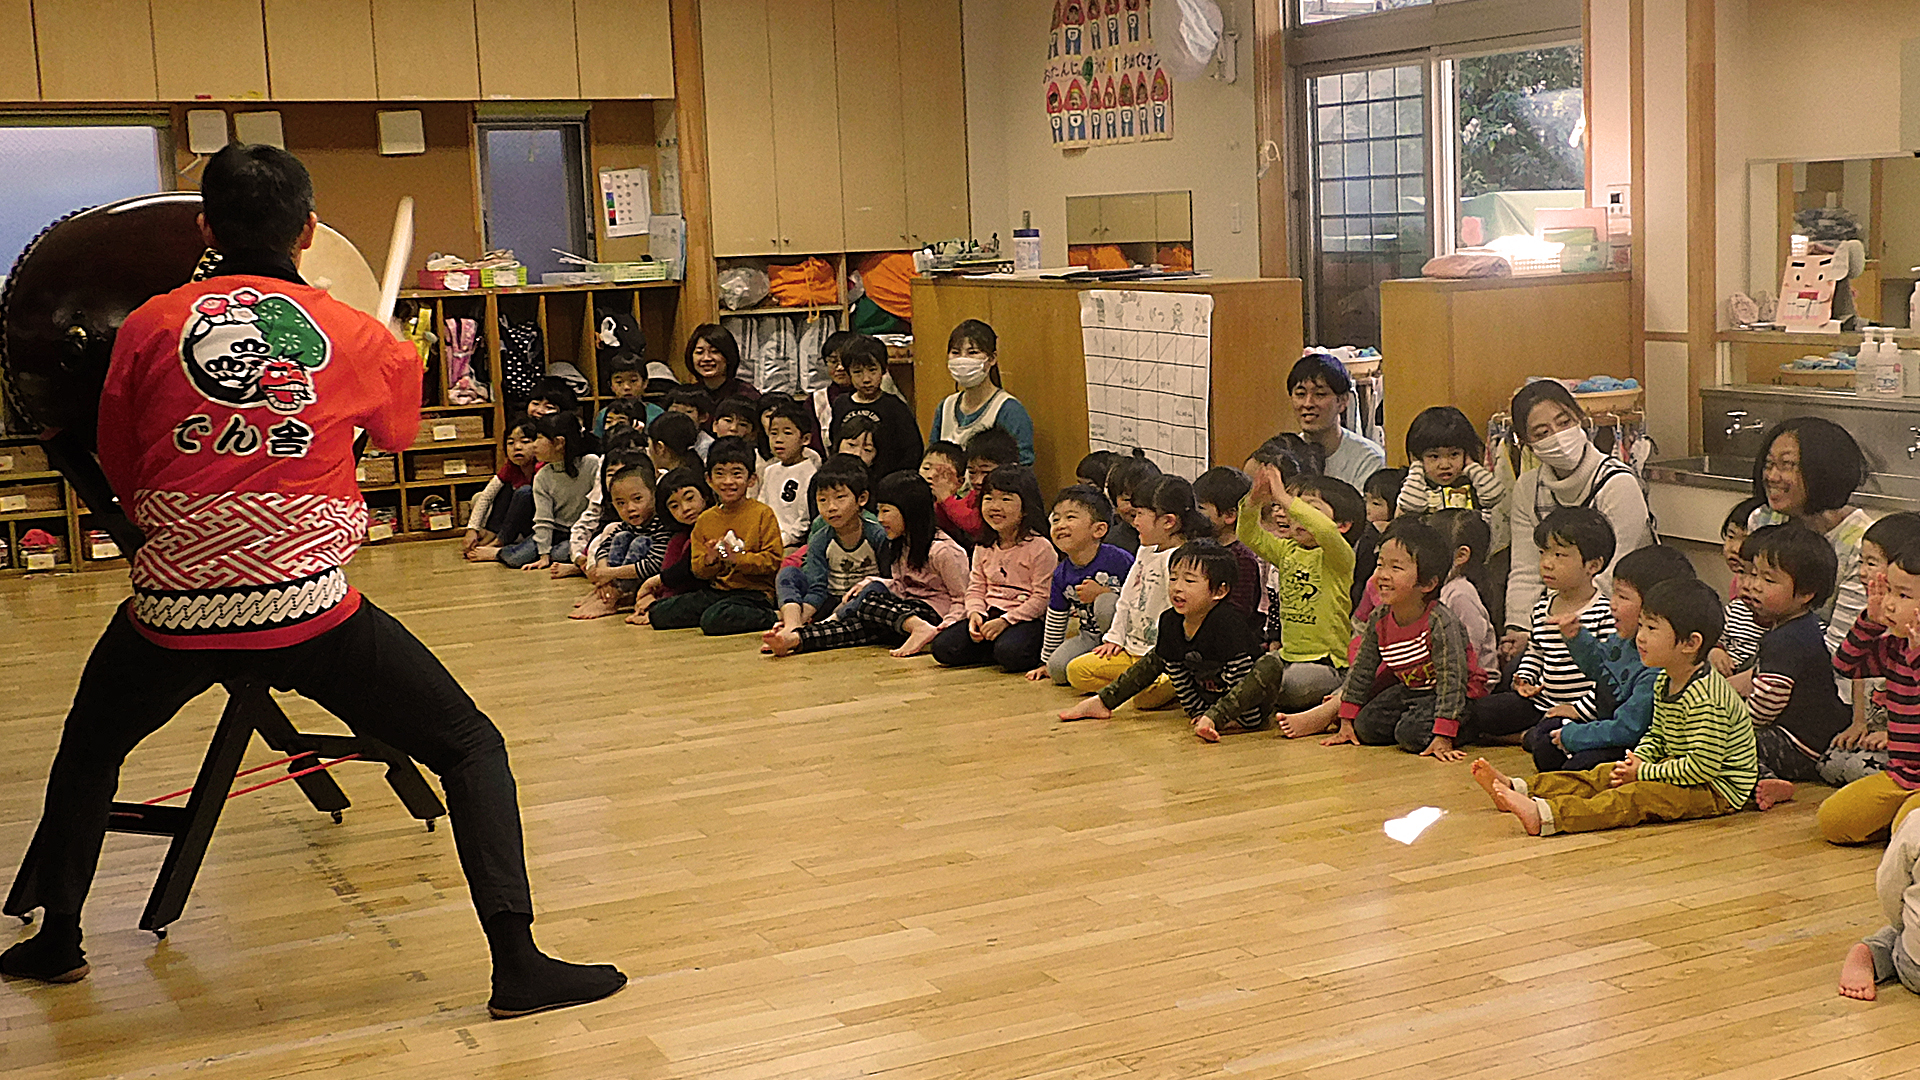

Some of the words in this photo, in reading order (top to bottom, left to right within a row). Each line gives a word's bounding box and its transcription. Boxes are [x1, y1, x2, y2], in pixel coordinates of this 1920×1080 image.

[173, 414, 314, 457] でん舎
[780, 478, 799, 503] S
